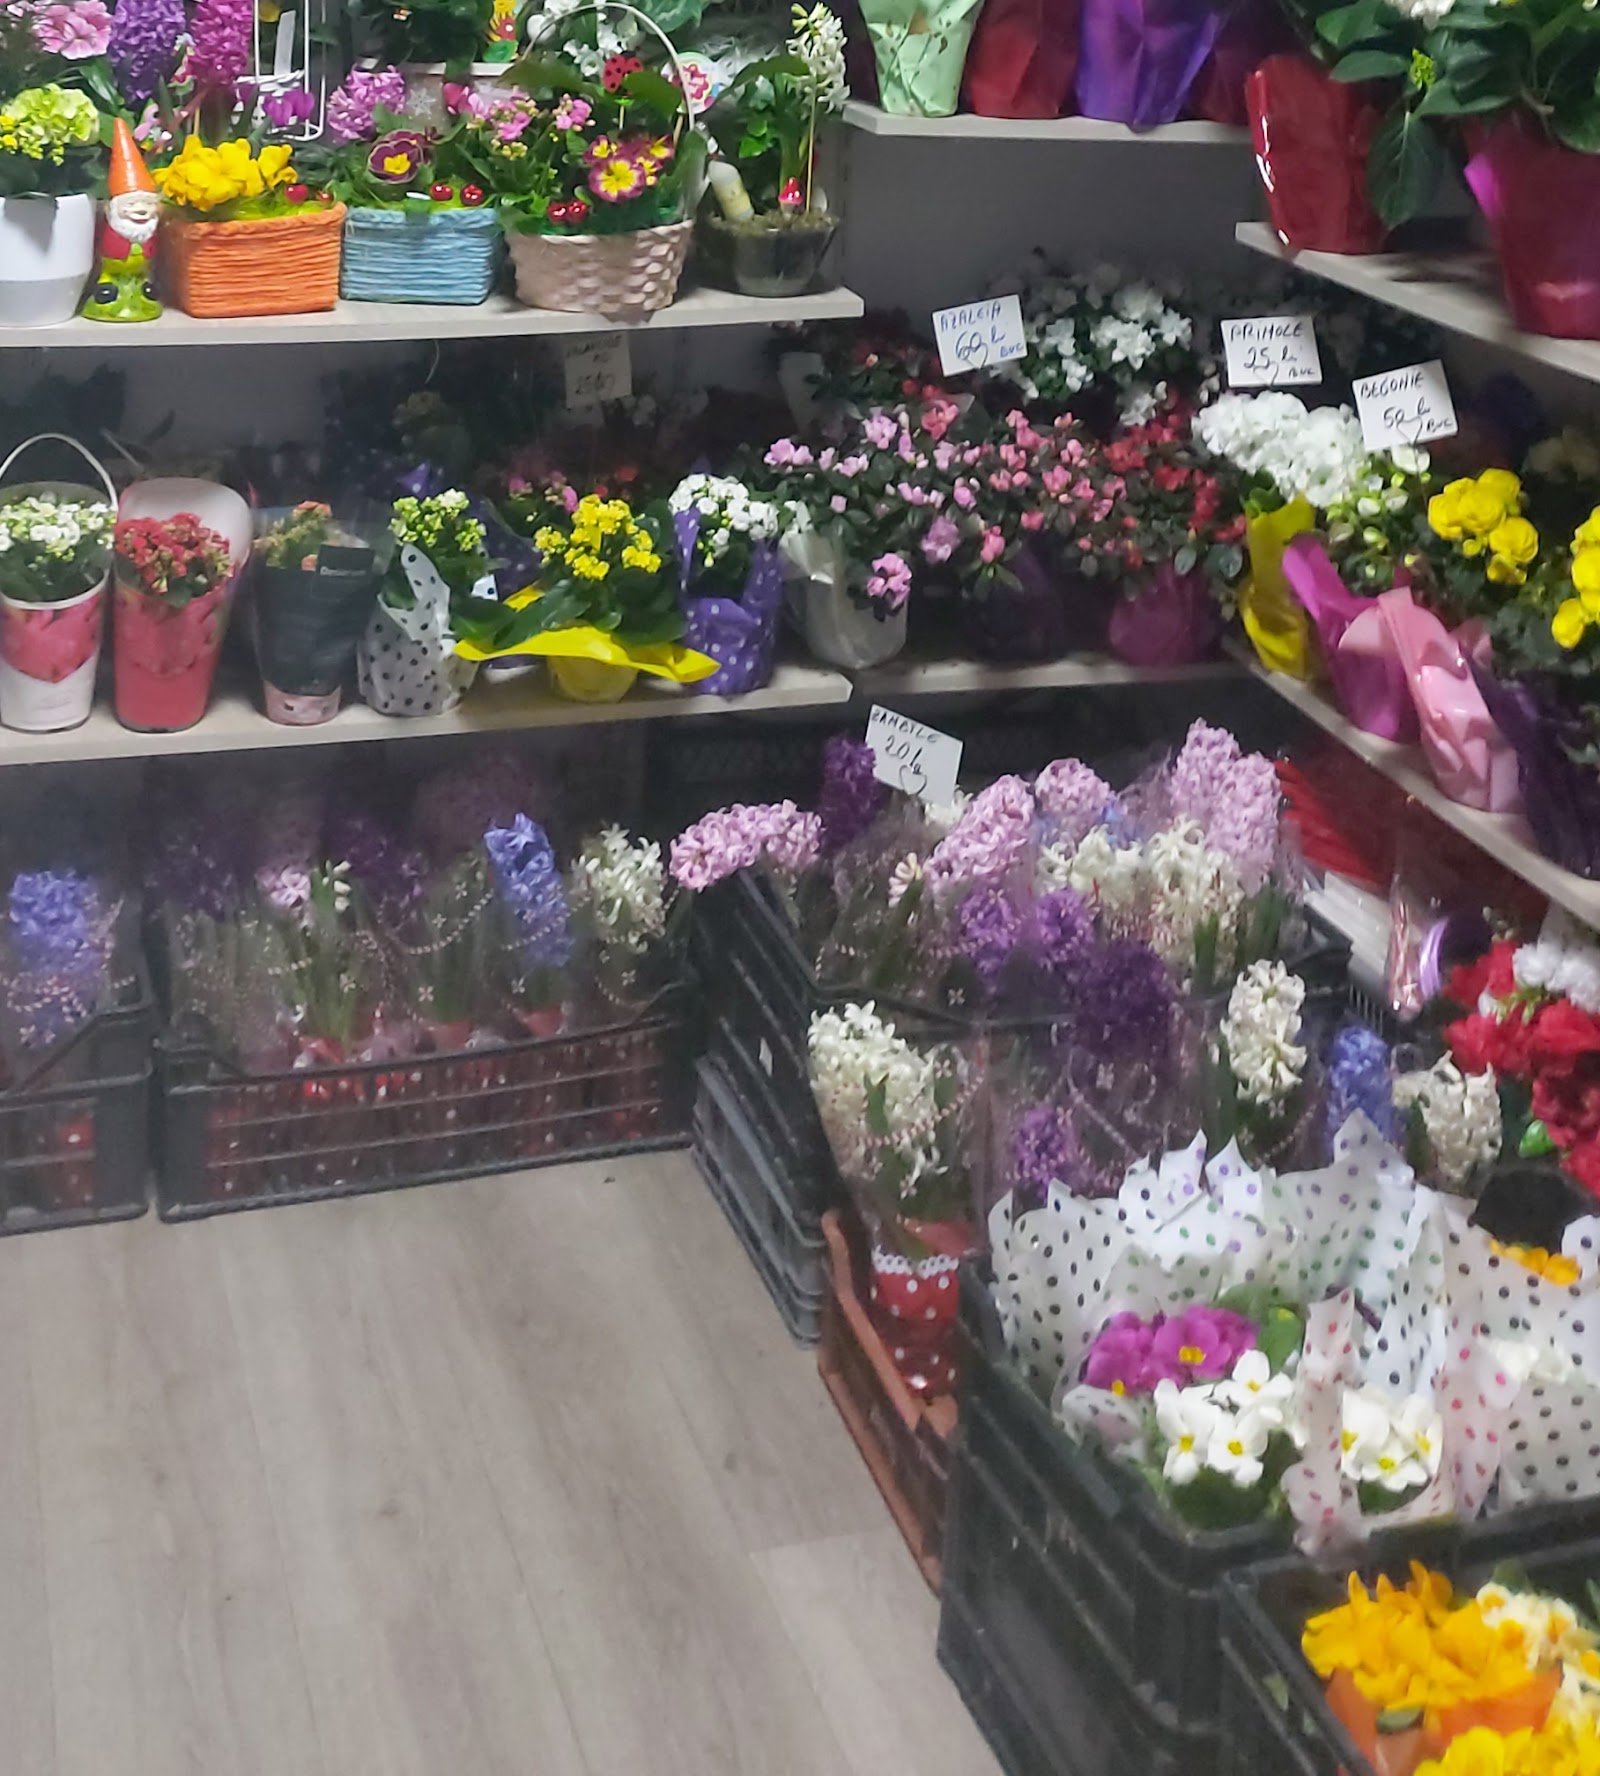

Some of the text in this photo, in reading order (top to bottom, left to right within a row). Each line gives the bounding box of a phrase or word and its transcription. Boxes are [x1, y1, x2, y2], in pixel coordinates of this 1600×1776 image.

[955, 331, 982, 361] 60
[1243, 346, 1271, 370] 25
[1383, 405, 1405, 429] 50
[884, 735, 911, 760] 20
